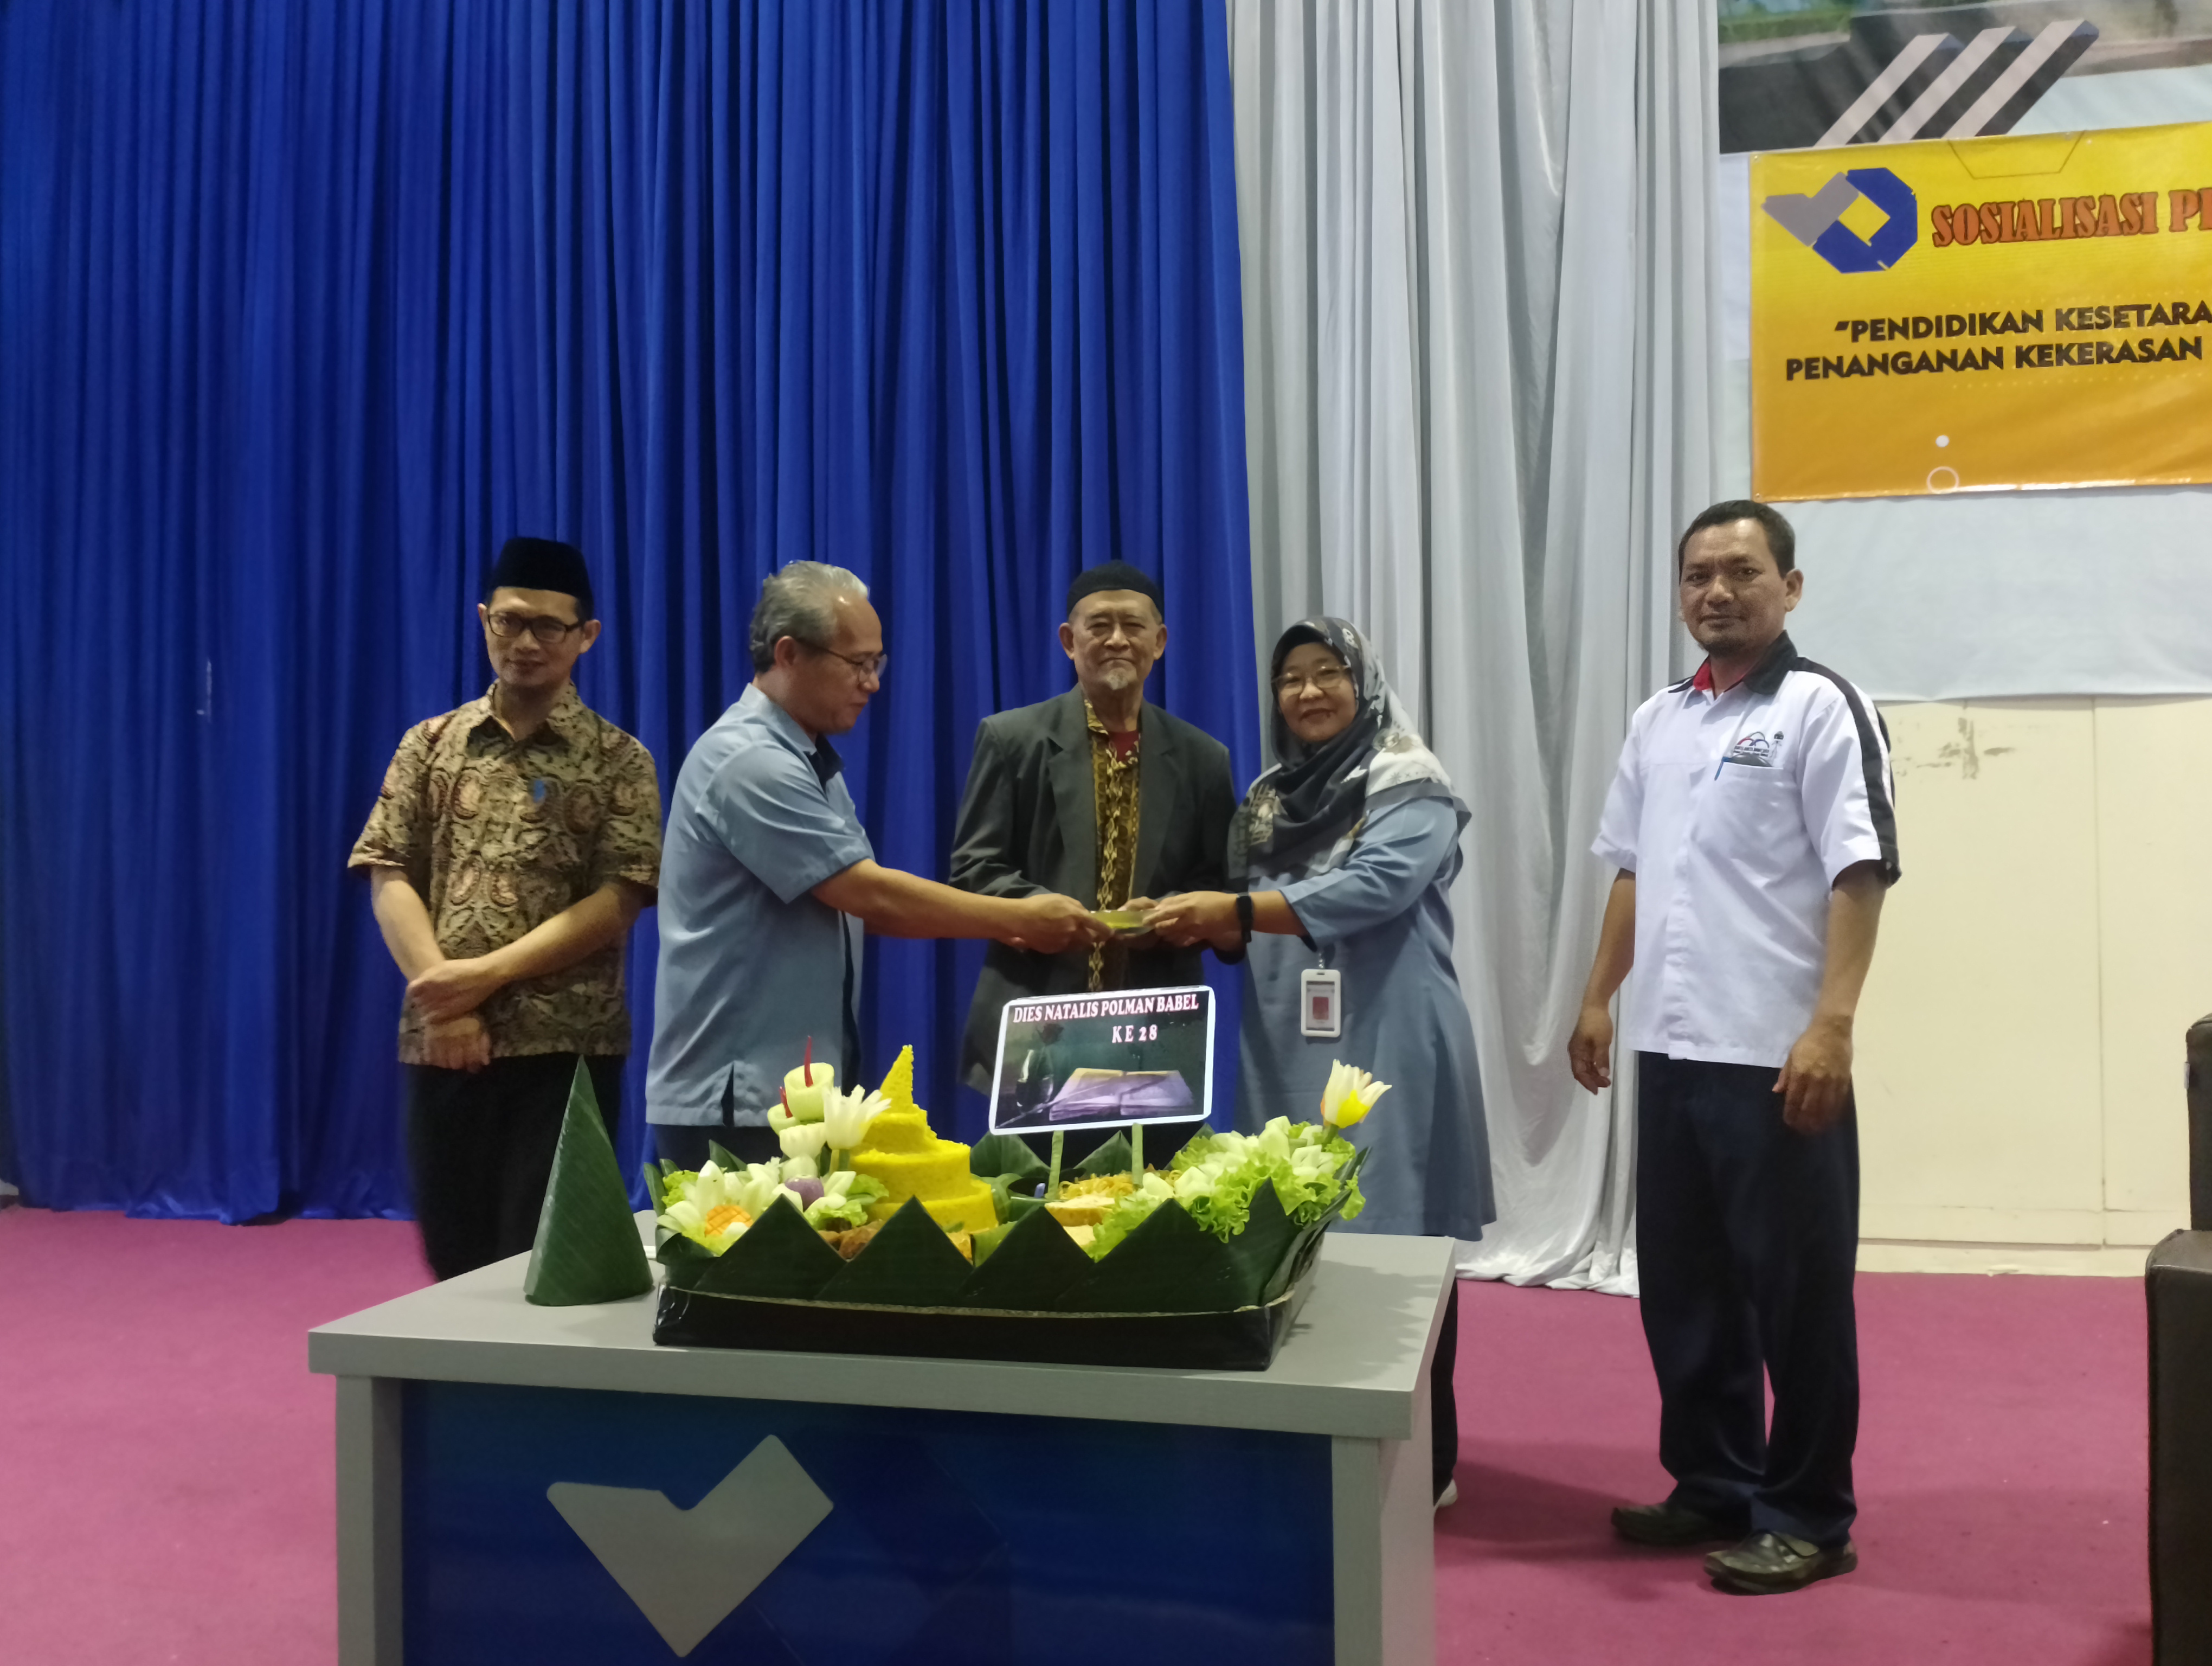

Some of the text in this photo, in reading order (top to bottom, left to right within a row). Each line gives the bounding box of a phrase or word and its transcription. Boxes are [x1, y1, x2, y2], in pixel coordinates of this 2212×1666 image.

[1931, 191, 2159, 247] SOSIALISASI
[2055, 300, 2212, 333] KESETARA
[1786, 336, 2202, 381] PENANGANAN KEKERASAN
[1013, 994, 1199, 1023] DIES NATALIS POLMAN BABEL
[1139, 1024, 1158, 1041] 28
